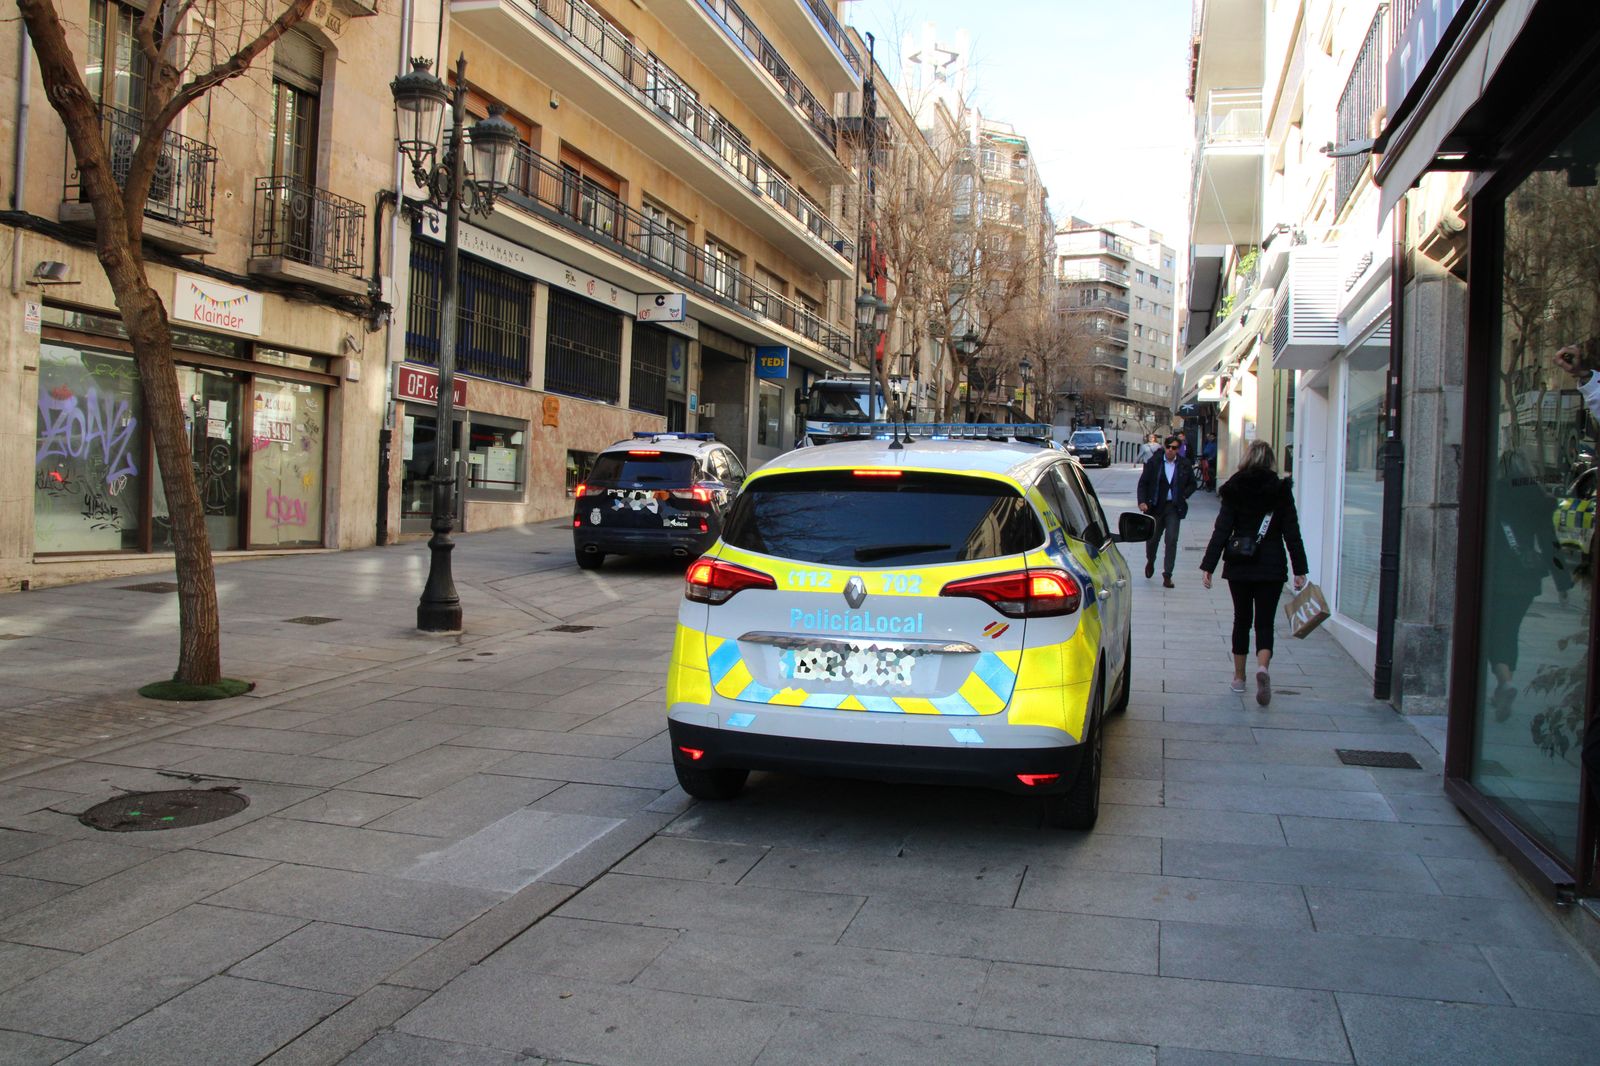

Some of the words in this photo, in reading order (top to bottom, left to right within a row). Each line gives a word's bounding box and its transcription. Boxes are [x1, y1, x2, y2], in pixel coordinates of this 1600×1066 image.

[474, 236, 525, 263] SALAMANCA
[193, 303, 244, 329] Klainder
[761, 356, 784, 367] TEDi
[407, 373, 427, 396] OFI
[881, 573, 923, 593] 702
